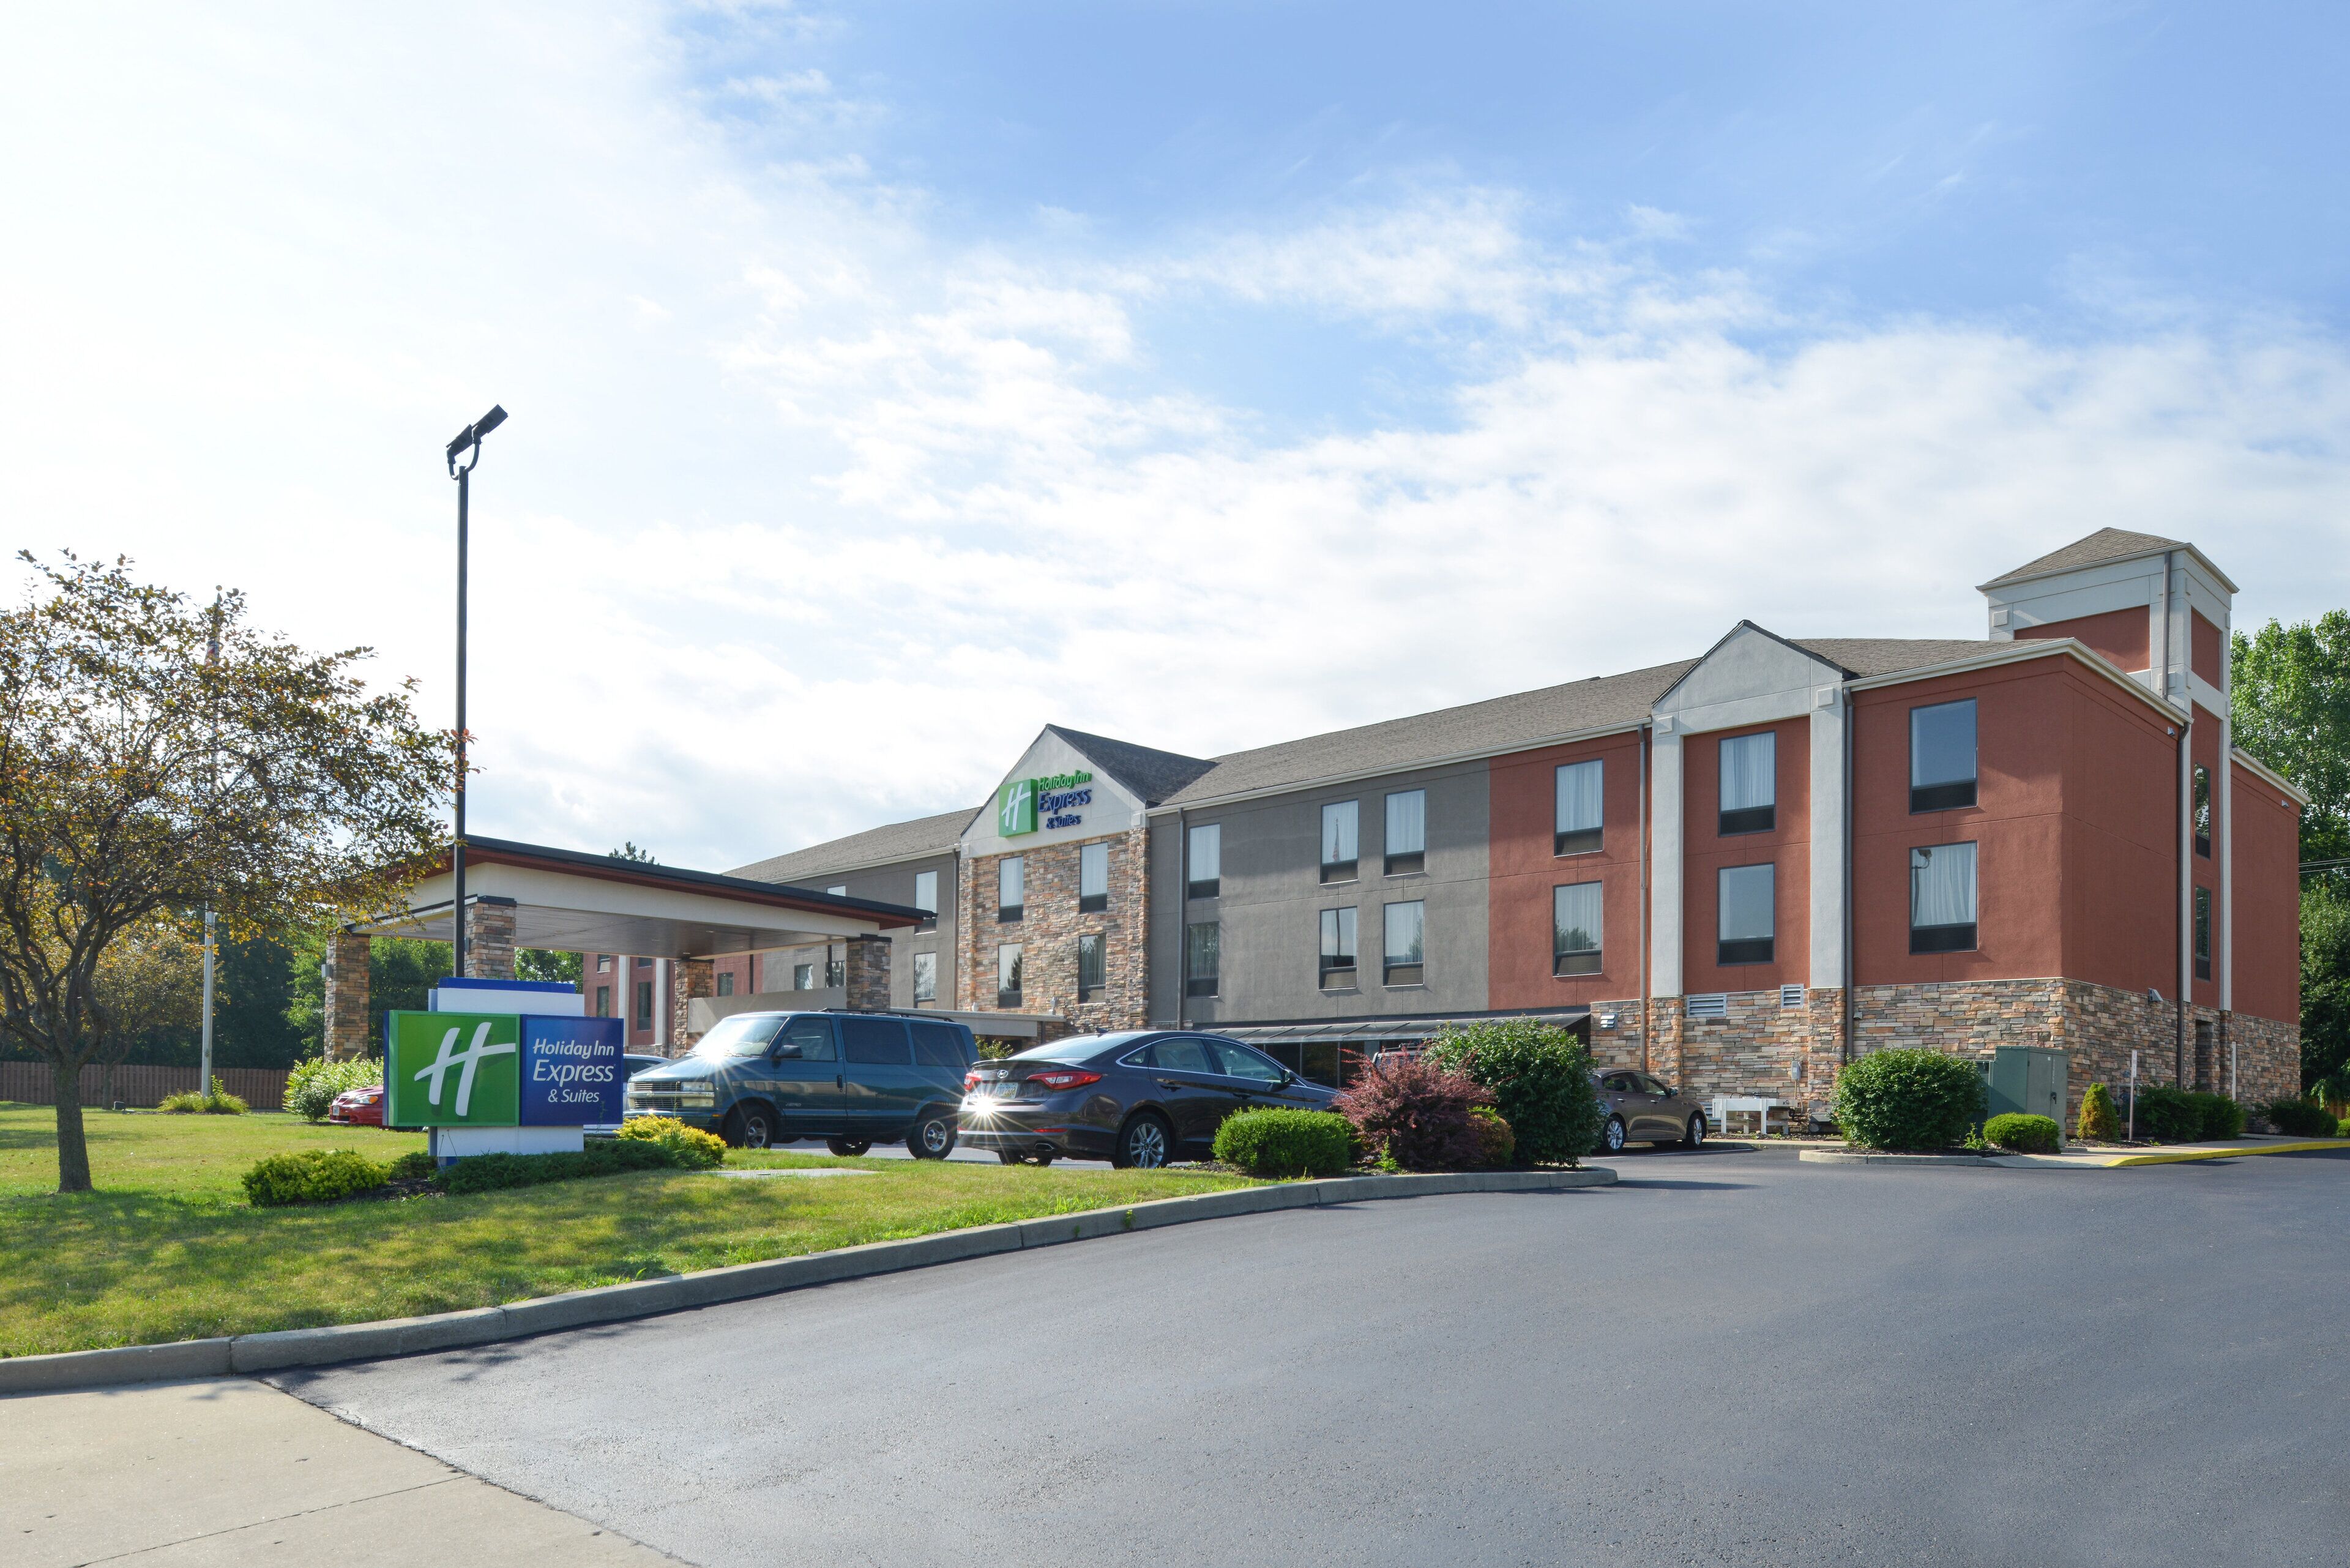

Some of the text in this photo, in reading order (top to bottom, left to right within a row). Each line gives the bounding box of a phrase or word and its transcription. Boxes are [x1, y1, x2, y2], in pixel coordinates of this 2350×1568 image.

[1039, 769, 1092, 791] Holiday Inn
[1038, 788, 1092, 815] Express
[1046, 815, 1081, 829] & Suites
[532, 1038, 614, 1059] Holiday Inn
[532, 1059, 614, 1088] Express
[548, 1089, 600, 1103] & Suites
